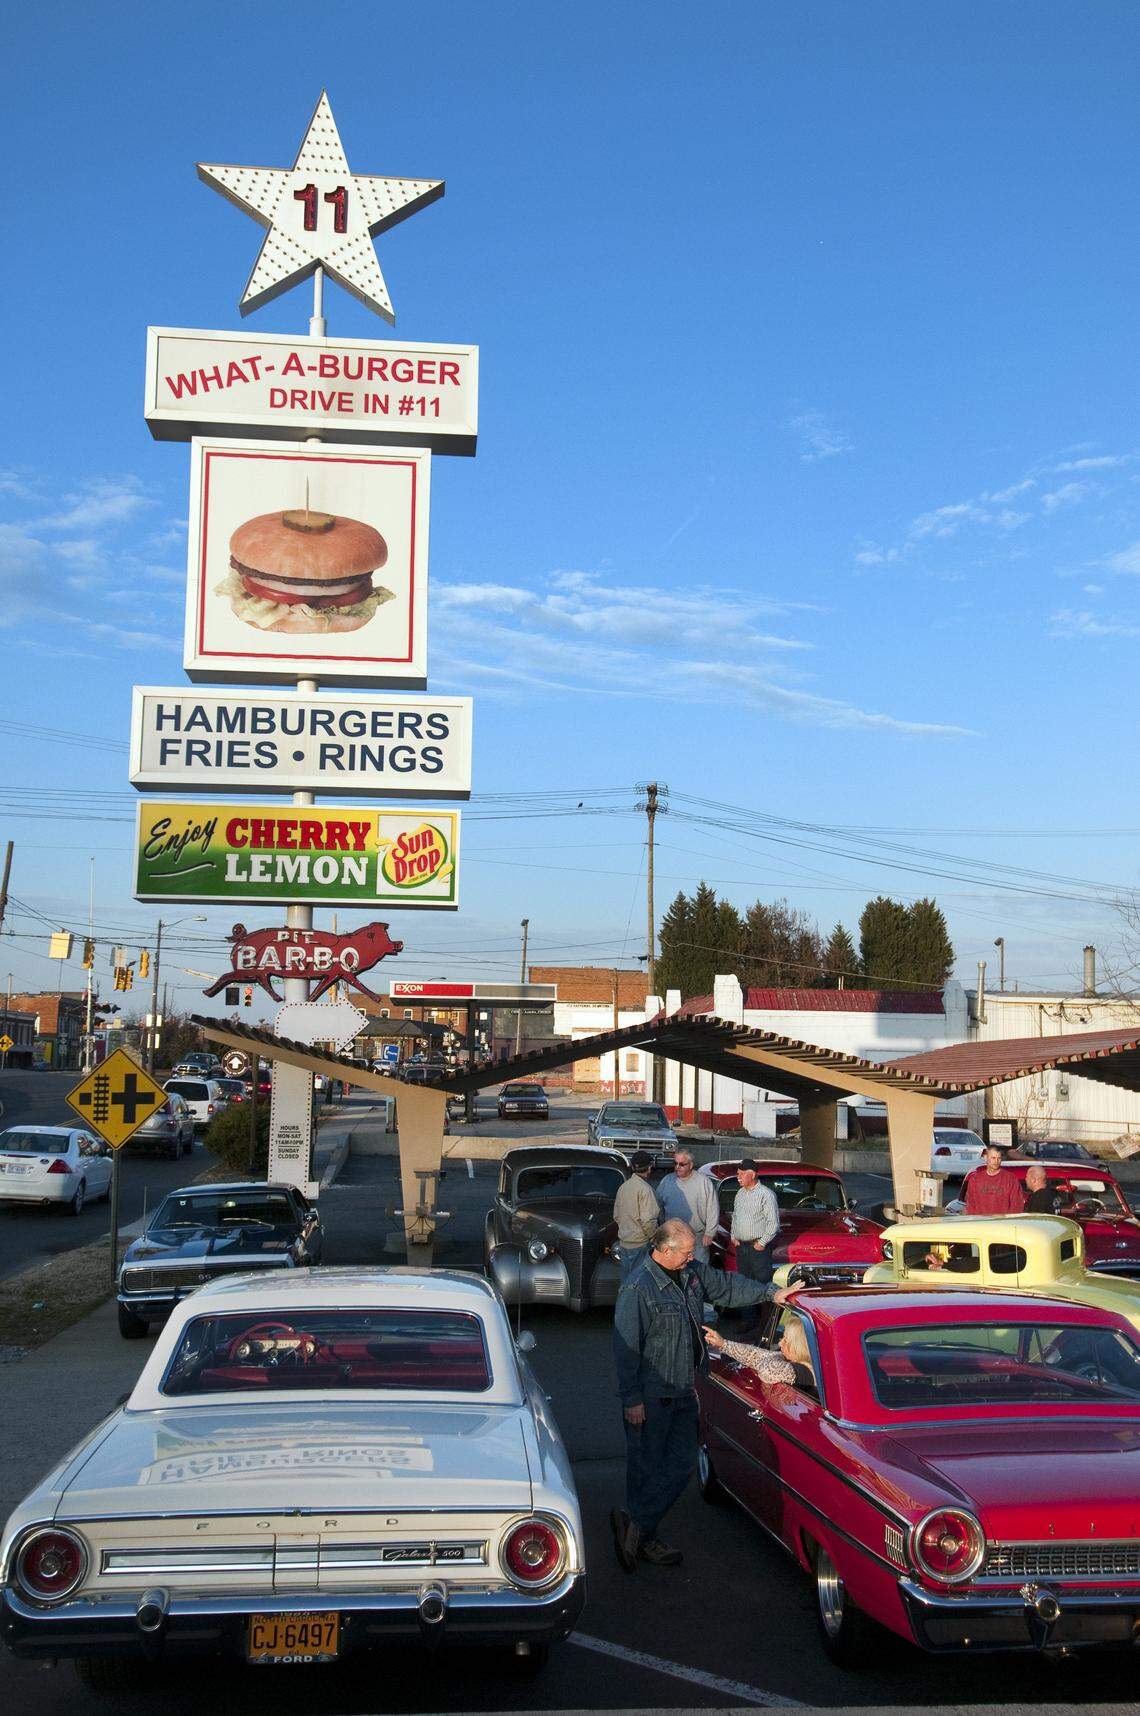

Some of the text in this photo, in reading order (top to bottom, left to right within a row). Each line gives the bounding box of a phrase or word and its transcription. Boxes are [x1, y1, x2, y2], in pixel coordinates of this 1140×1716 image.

[294, 183, 348, 233] 11
[269, 388, 441, 417] DRIVE IN #11
[155, 703, 450, 740] HAMBURGERS
[159, 738, 444, 773] FRIES RINGS
[144, 816, 371, 865] Enjoy CHERRY
[391, 829, 434, 860] Sun
[224, 852, 369, 886] LEMON
[394, 848, 441, 884] Drop
[276, 930, 318, 944] PIT
[237, 945, 360, 973] BAR-B-Q
[395, 983, 424, 993] EXXON
[441, 1549, 461, 1557] 500
[273, 1655, 313, 1663] FORD
